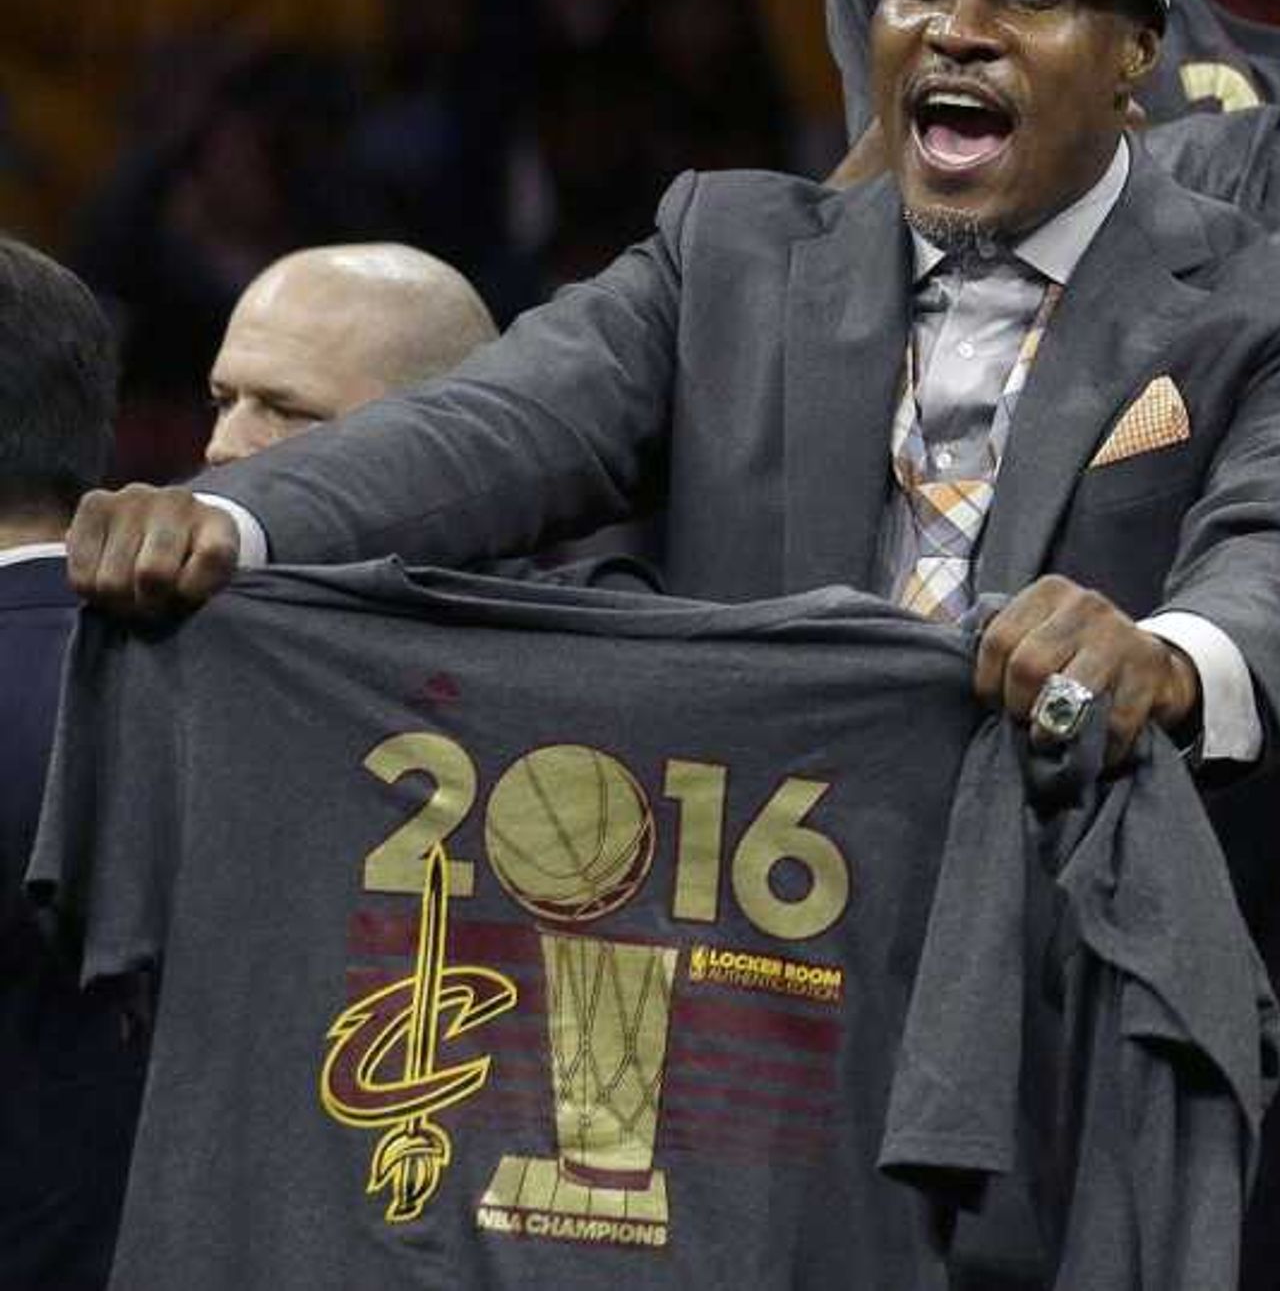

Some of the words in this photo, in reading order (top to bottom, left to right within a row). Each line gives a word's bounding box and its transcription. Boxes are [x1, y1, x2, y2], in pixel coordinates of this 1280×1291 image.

[363, 731, 850, 941] 2016
[709, 948, 783, 976] LOCKER
[784, 962, 842, 986] ROOM
[476, 1208, 521, 1233] NBA
[525, 1212, 667, 1246] CHAMPIONS
